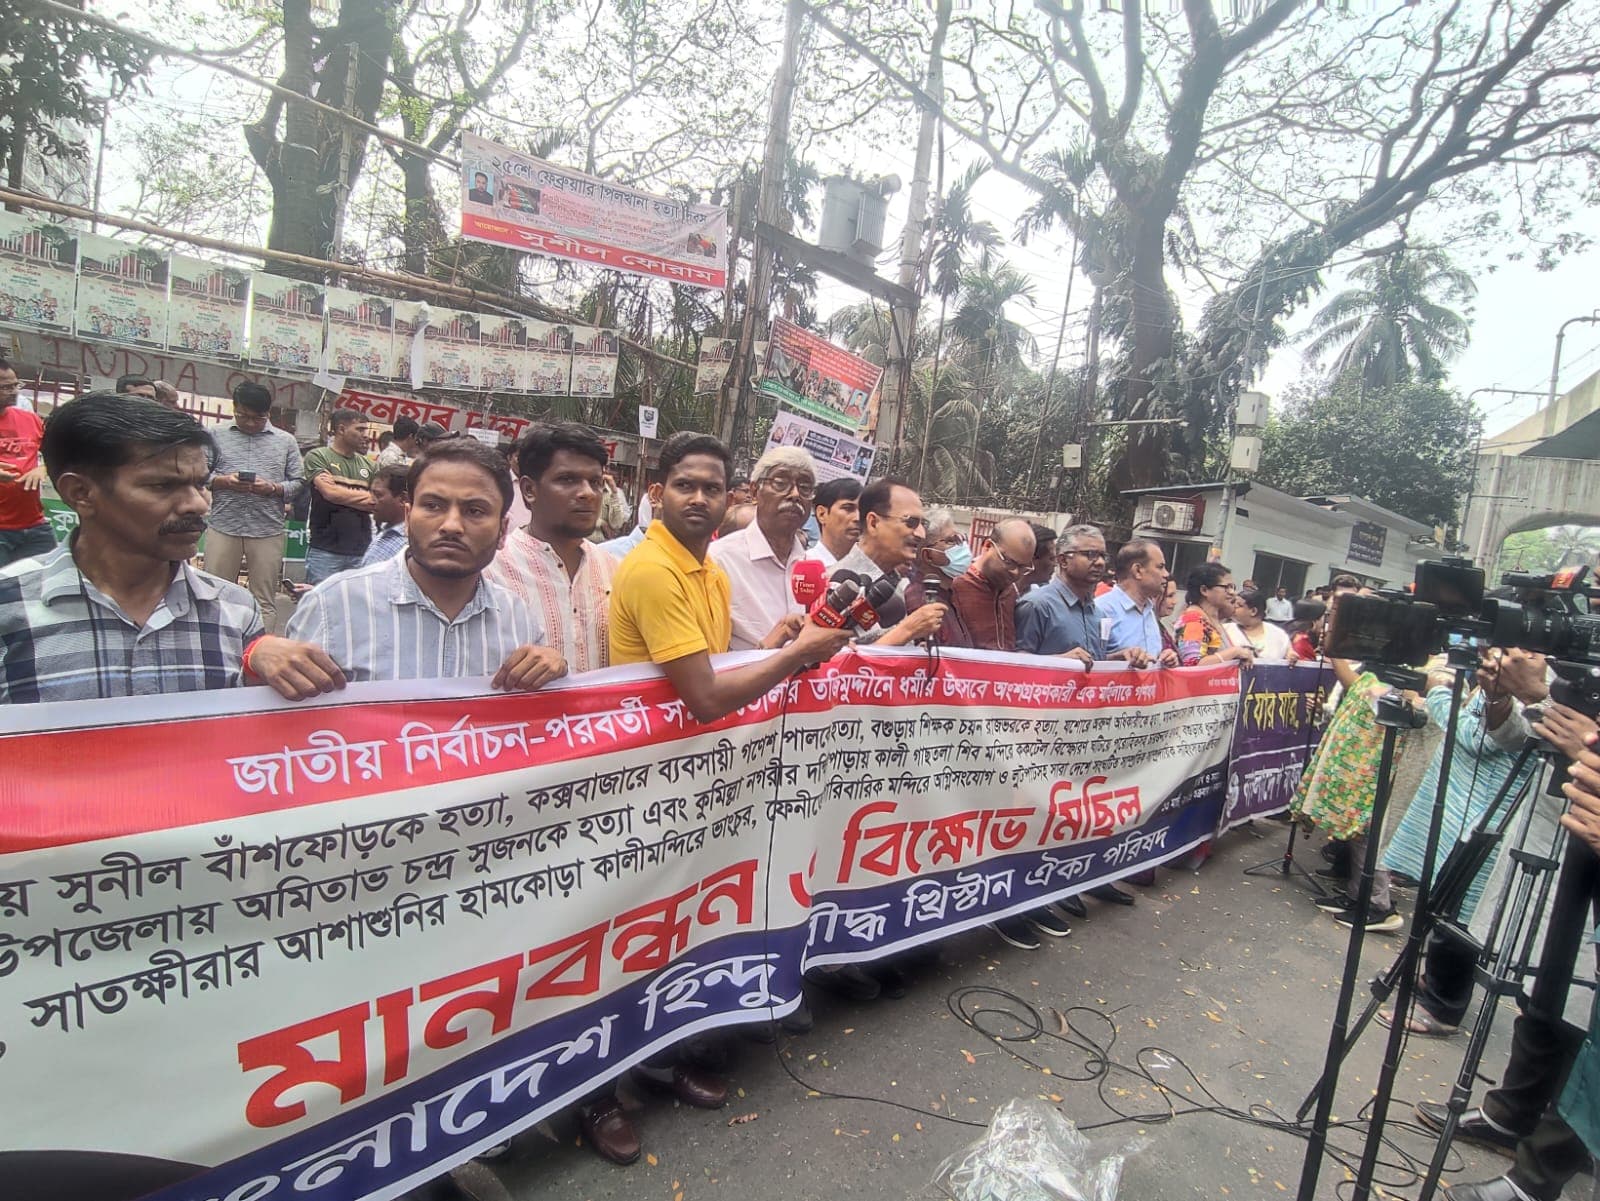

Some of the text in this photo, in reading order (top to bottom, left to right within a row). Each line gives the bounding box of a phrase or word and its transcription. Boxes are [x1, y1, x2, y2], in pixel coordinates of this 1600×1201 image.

[622, 255, 716, 282] ফোরাম
[41, 338, 200, 390] INDIA
[226, 730, 389, 795] জাতীয়
[396, 695, 651, 776] নির্বাচন-পরবর্তী
[1076, 686, 1096, 704] এক
[50, 851, 192, 913] সুনীল
[201, 812, 429, 882] বাঁশফোড়কে
[435, 792, 513, 836] হত্যা,
[526, 763, 653, 813] কক্সবাজারে
[658, 738, 736, 784] ব্যবসায়ী
[741, 729, 778, 763] গণেশ
[871, 718, 916, 743] বগুড়ায়
[920, 712, 956, 737] শিক্ষক
[959, 718, 983, 737] চয়ন
[232, 865, 394, 921] অমিতাভ
[401, 849, 460, 885] চন্দ্র
[466, 820, 571, 874] সুজনকে
[577, 803, 634, 844] হত্যা
[643, 796, 688, 827] এবং
[694, 777, 744, 820] কুমিল্লা
[874, 742, 911, 769] কালী
[956, 739, 985, 763] শিব
[836, 800, 1037, 885] বিক্ষোভ
[1036, 775, 1142, 846] মিছিল
[23, 941, 265, 1032] সাতক্ষীরার
[275, 892, 449, 964] আশাশুনির
[456, 857, 585, 919] হামকোড়া
[591, 825, 708, 881] কালীমন্দিরে
[888, 771, 931, 796] মন্দিরে
[999, 770, 1009, 785] ও
[902, 867, 1015, 928] খ্রিস্টান
[1025, 852, 1095, 886] ঐক্য
[1102, 827, 1170, 867] পরিষদ
[237, 858, 759, 1129] মানবন্ধন
[638, 952, 786, 1031] হিন্দু
